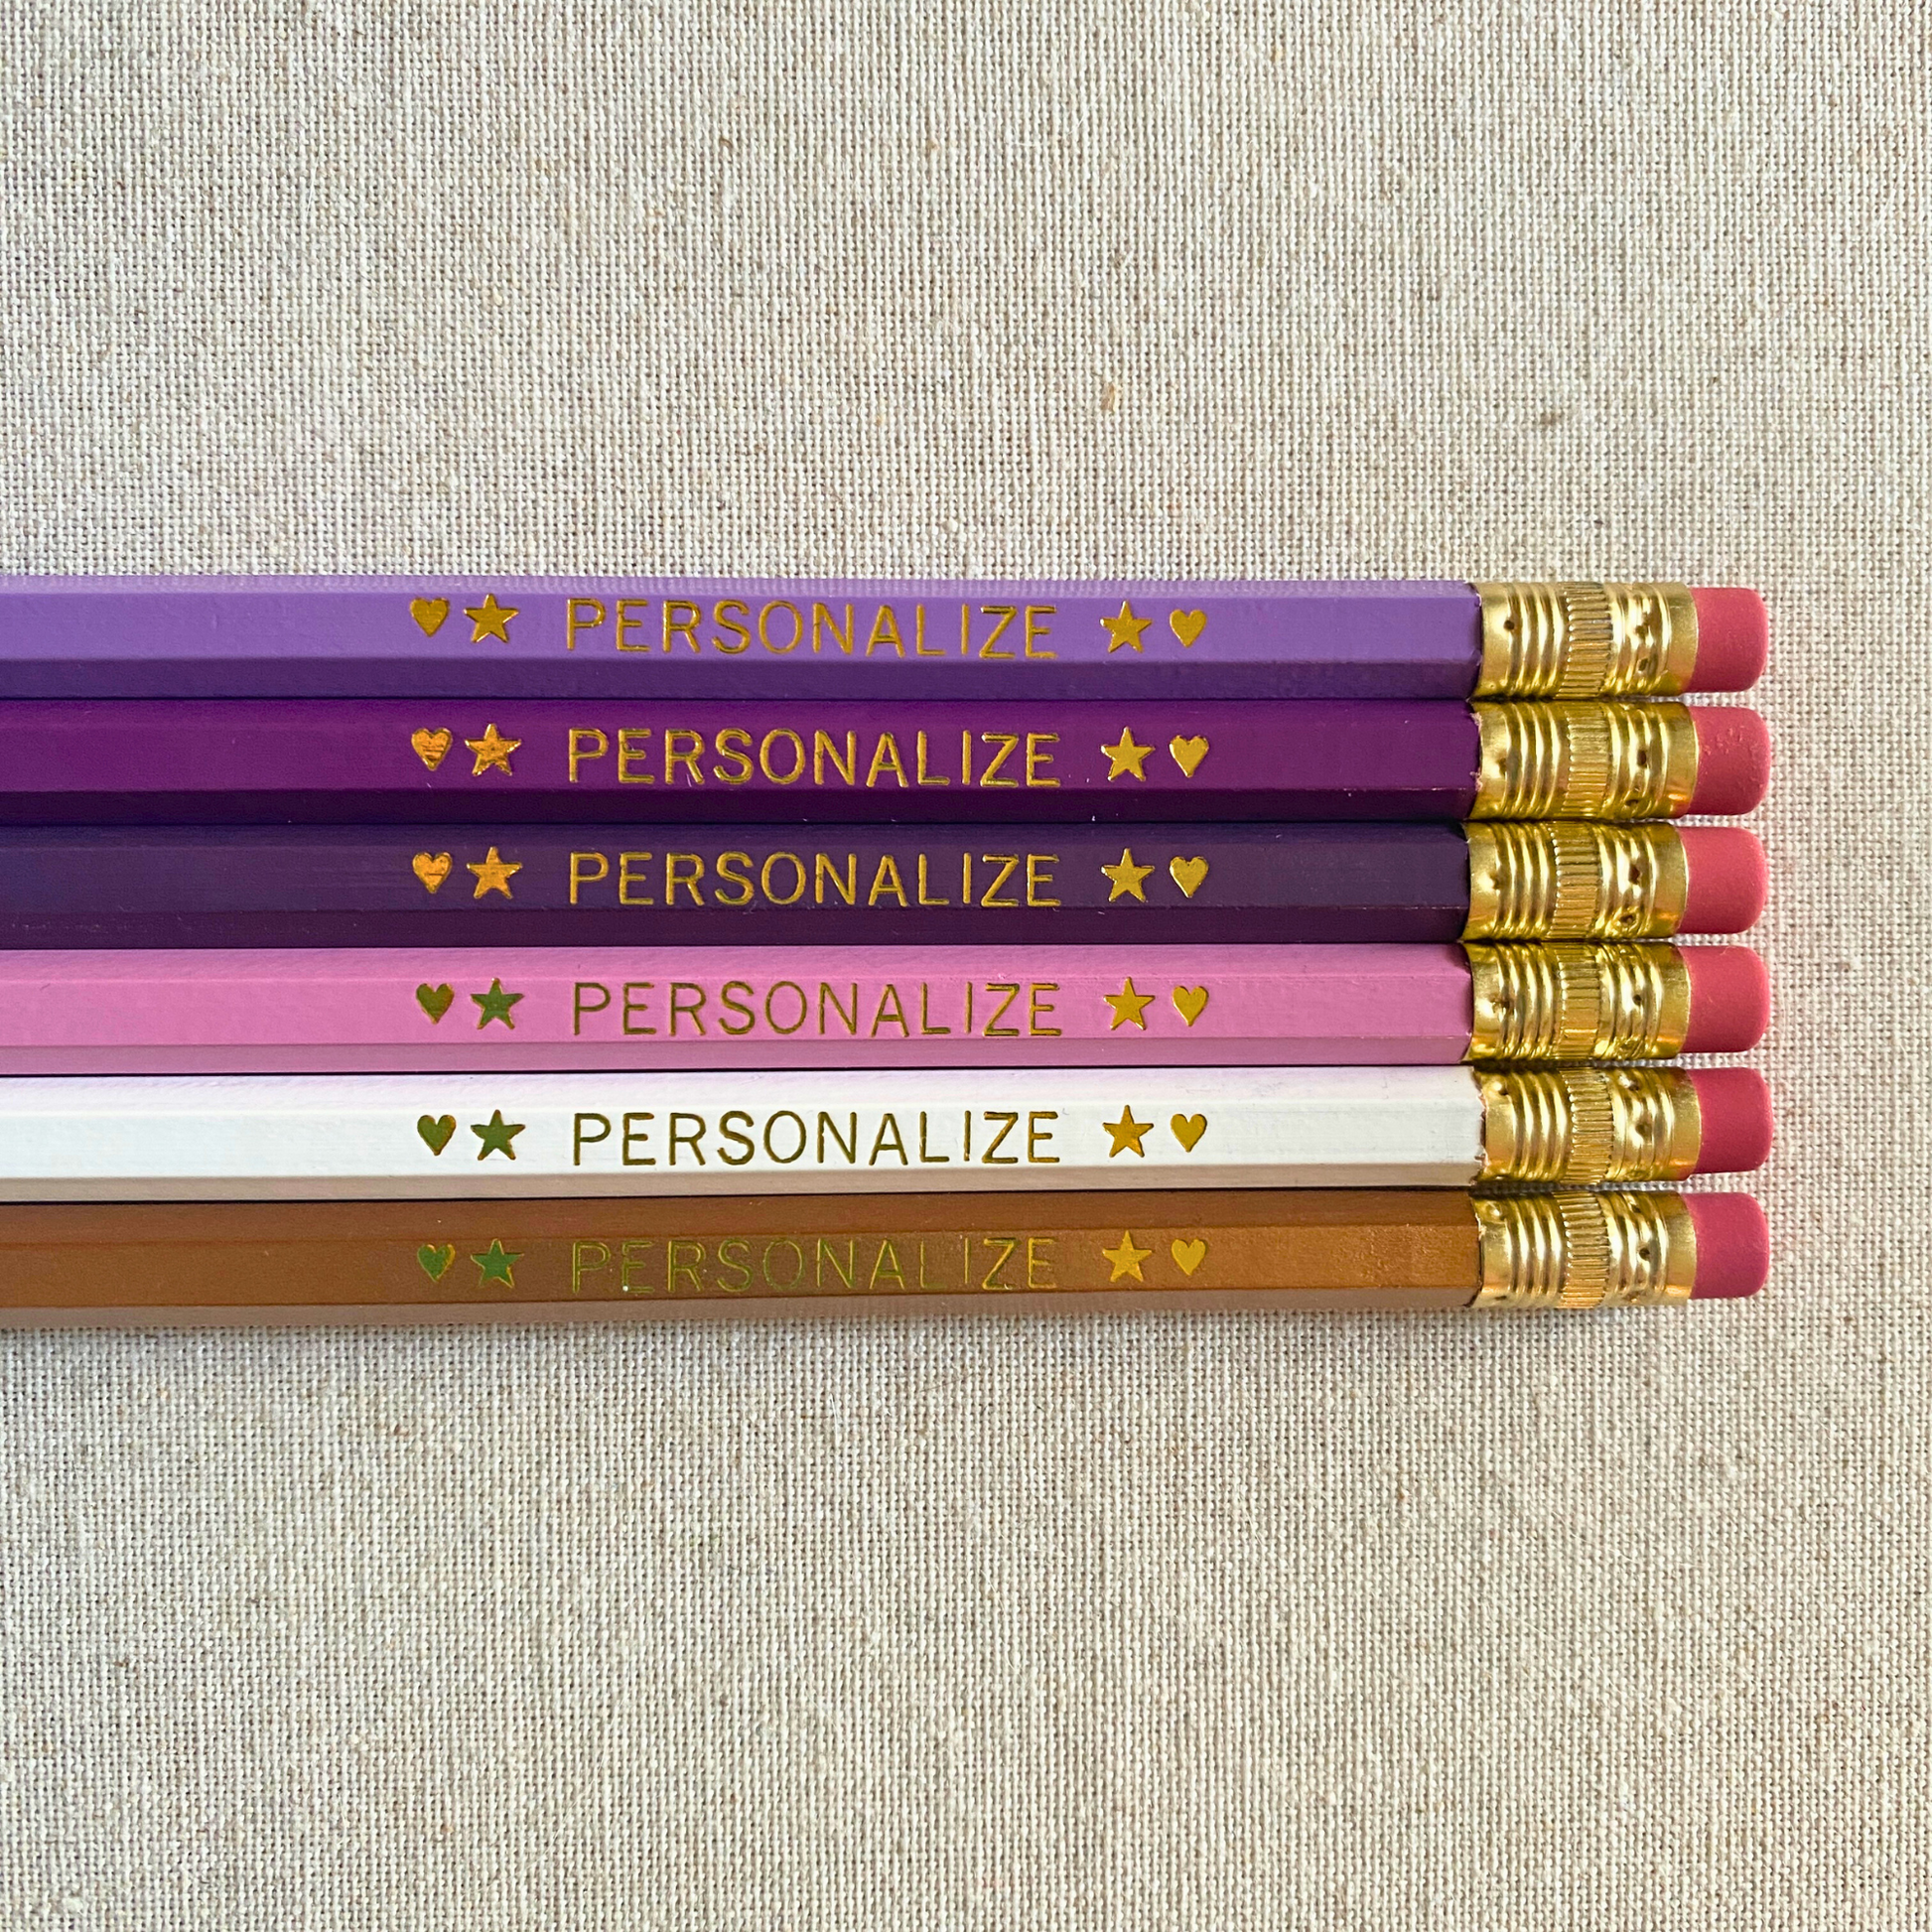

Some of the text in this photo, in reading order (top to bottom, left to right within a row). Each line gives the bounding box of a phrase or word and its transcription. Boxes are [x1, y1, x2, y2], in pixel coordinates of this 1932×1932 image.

[566, 598, 1058, 659] PERSONALIZE
[568, 727, 1062, 788] PERSONALIZE
[569, 850, 1062, 908] PERSONALIZE
[573, 980, 1063, 1037] PERSONALIZE
[573, 1110, 1061, 1167] PERSONALIZE
[572, 1237, 1058, 1294] PERSONALIZE
